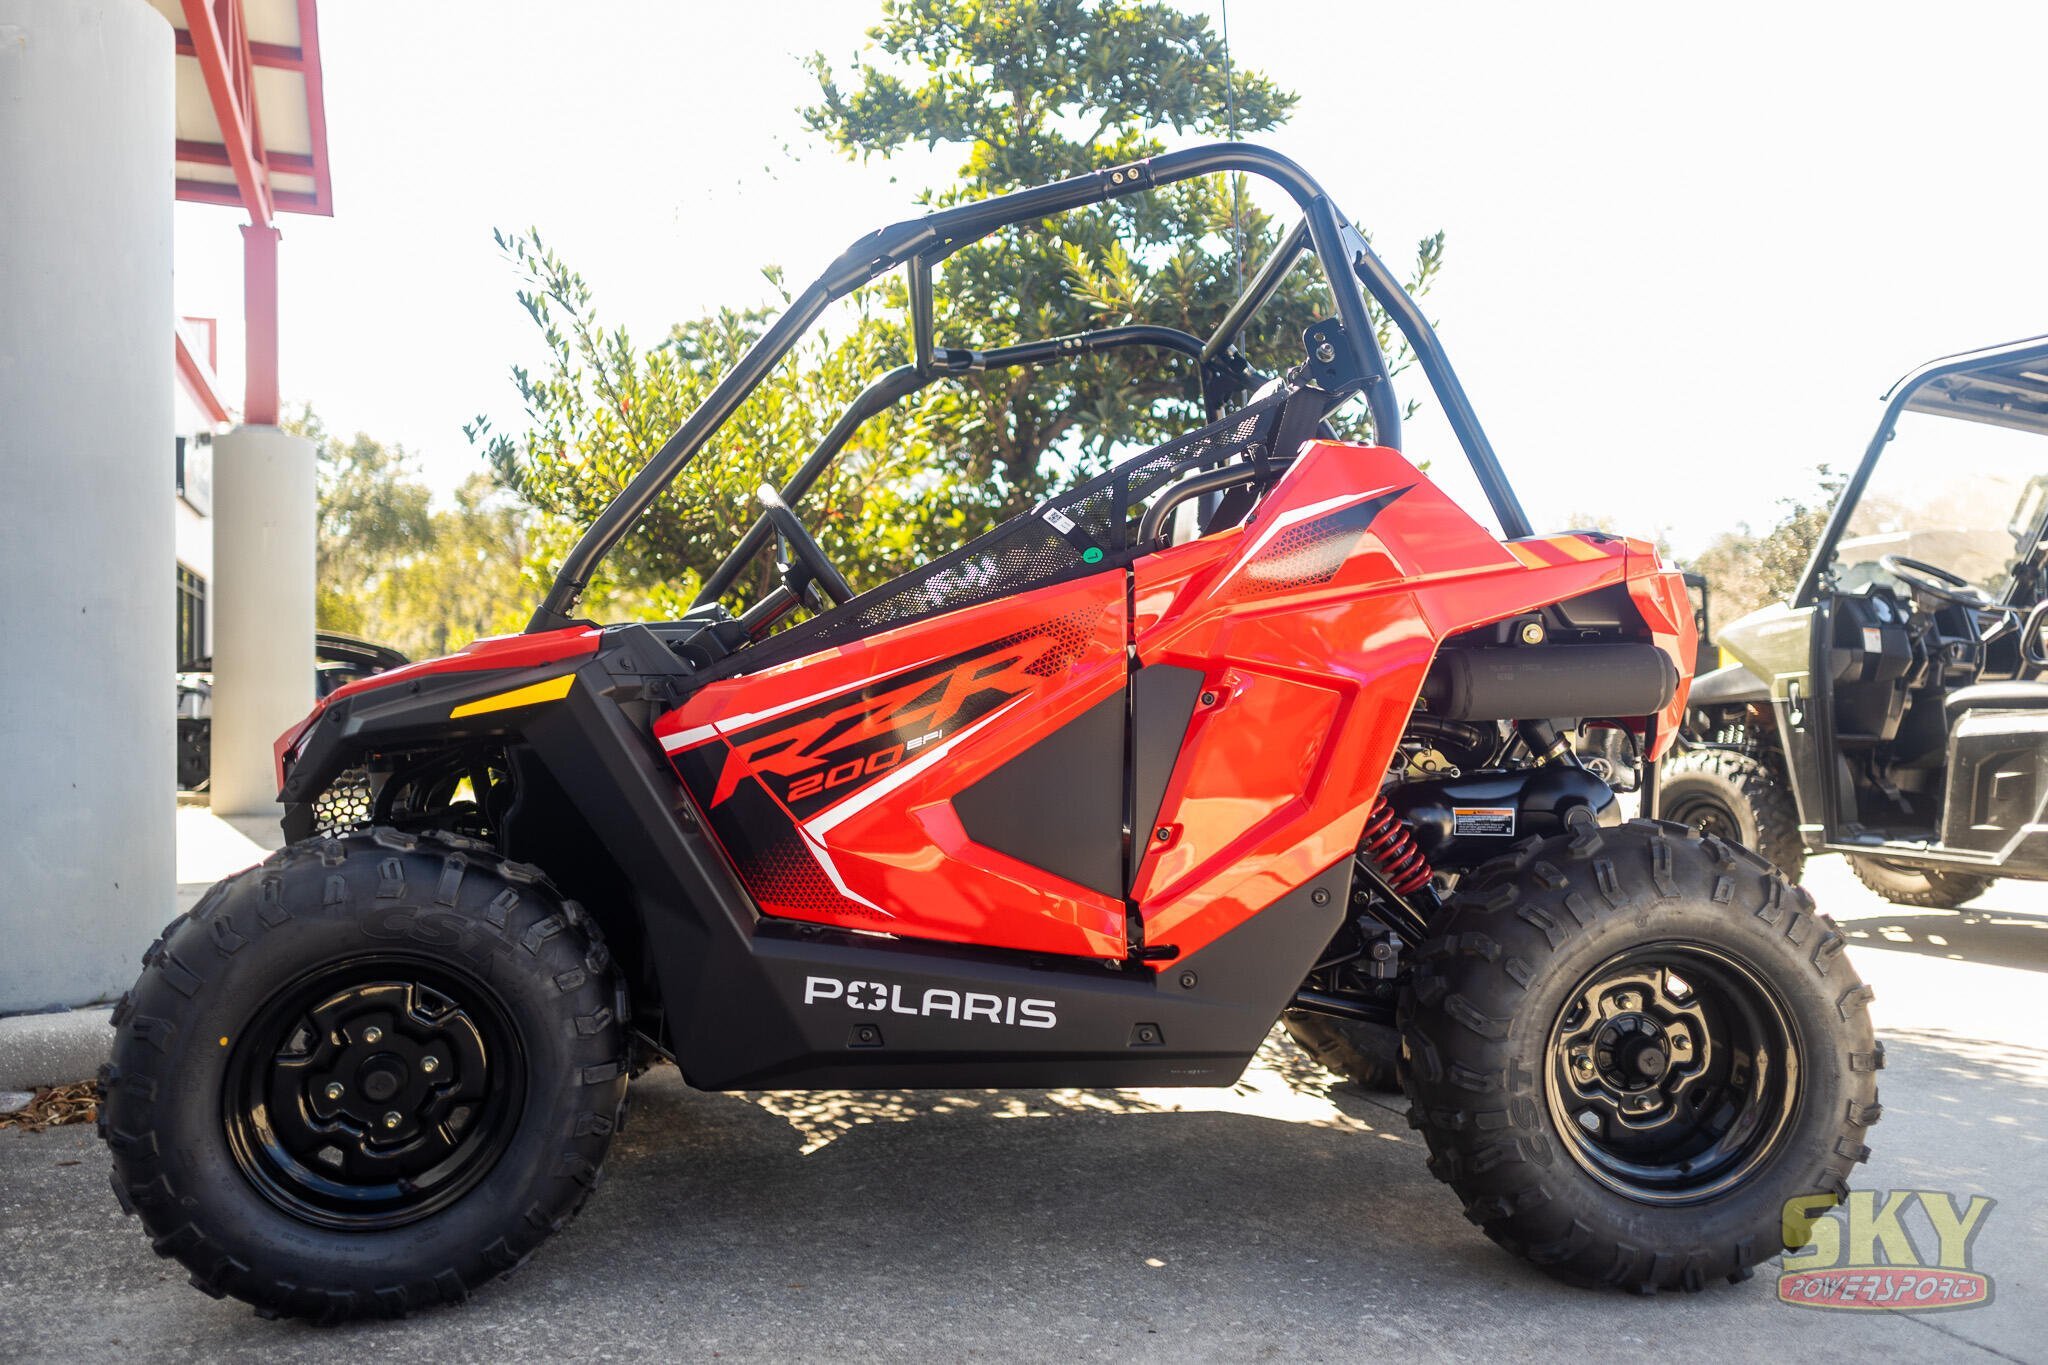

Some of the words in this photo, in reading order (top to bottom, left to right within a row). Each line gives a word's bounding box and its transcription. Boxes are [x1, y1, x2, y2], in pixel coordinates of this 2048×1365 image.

[710, 637, 1061, 810] RZR
[787, 742, 905, 803] 200
[360, 904, 515, 964] CST
[803, 975, 1058, 1030] POLARIS
[1508, 1057, 1554, 1169] CST
